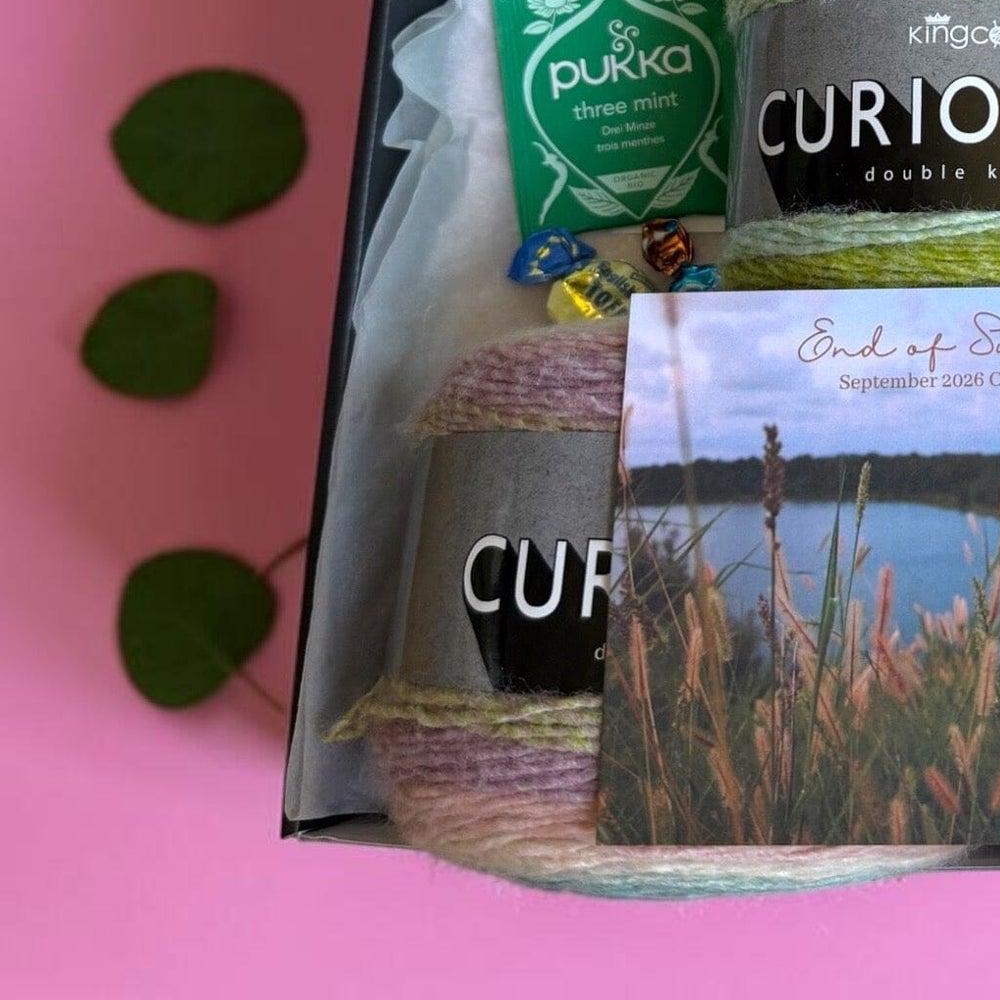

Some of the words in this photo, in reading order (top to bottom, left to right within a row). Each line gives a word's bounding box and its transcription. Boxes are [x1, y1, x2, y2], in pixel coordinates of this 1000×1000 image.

[549, 19, 694, 100] pukka
[572, 100, 628, 121] three
[633, 91, 680, 112] mint
[601, 124, 623, 137] Drei
[626, 120, 657, 133] Minze
[596, 140, 620, 153] trois
[621, 134, 666, 149] menthes
[613, 171, 658, 183] ORGANIC
[864, 163, 966, 183] double
[798, 317, 898, 363] End
[907, 332, 957, 374] of
[838, 373, 938, 393] September
[941, 372, 985, 388] 2026
